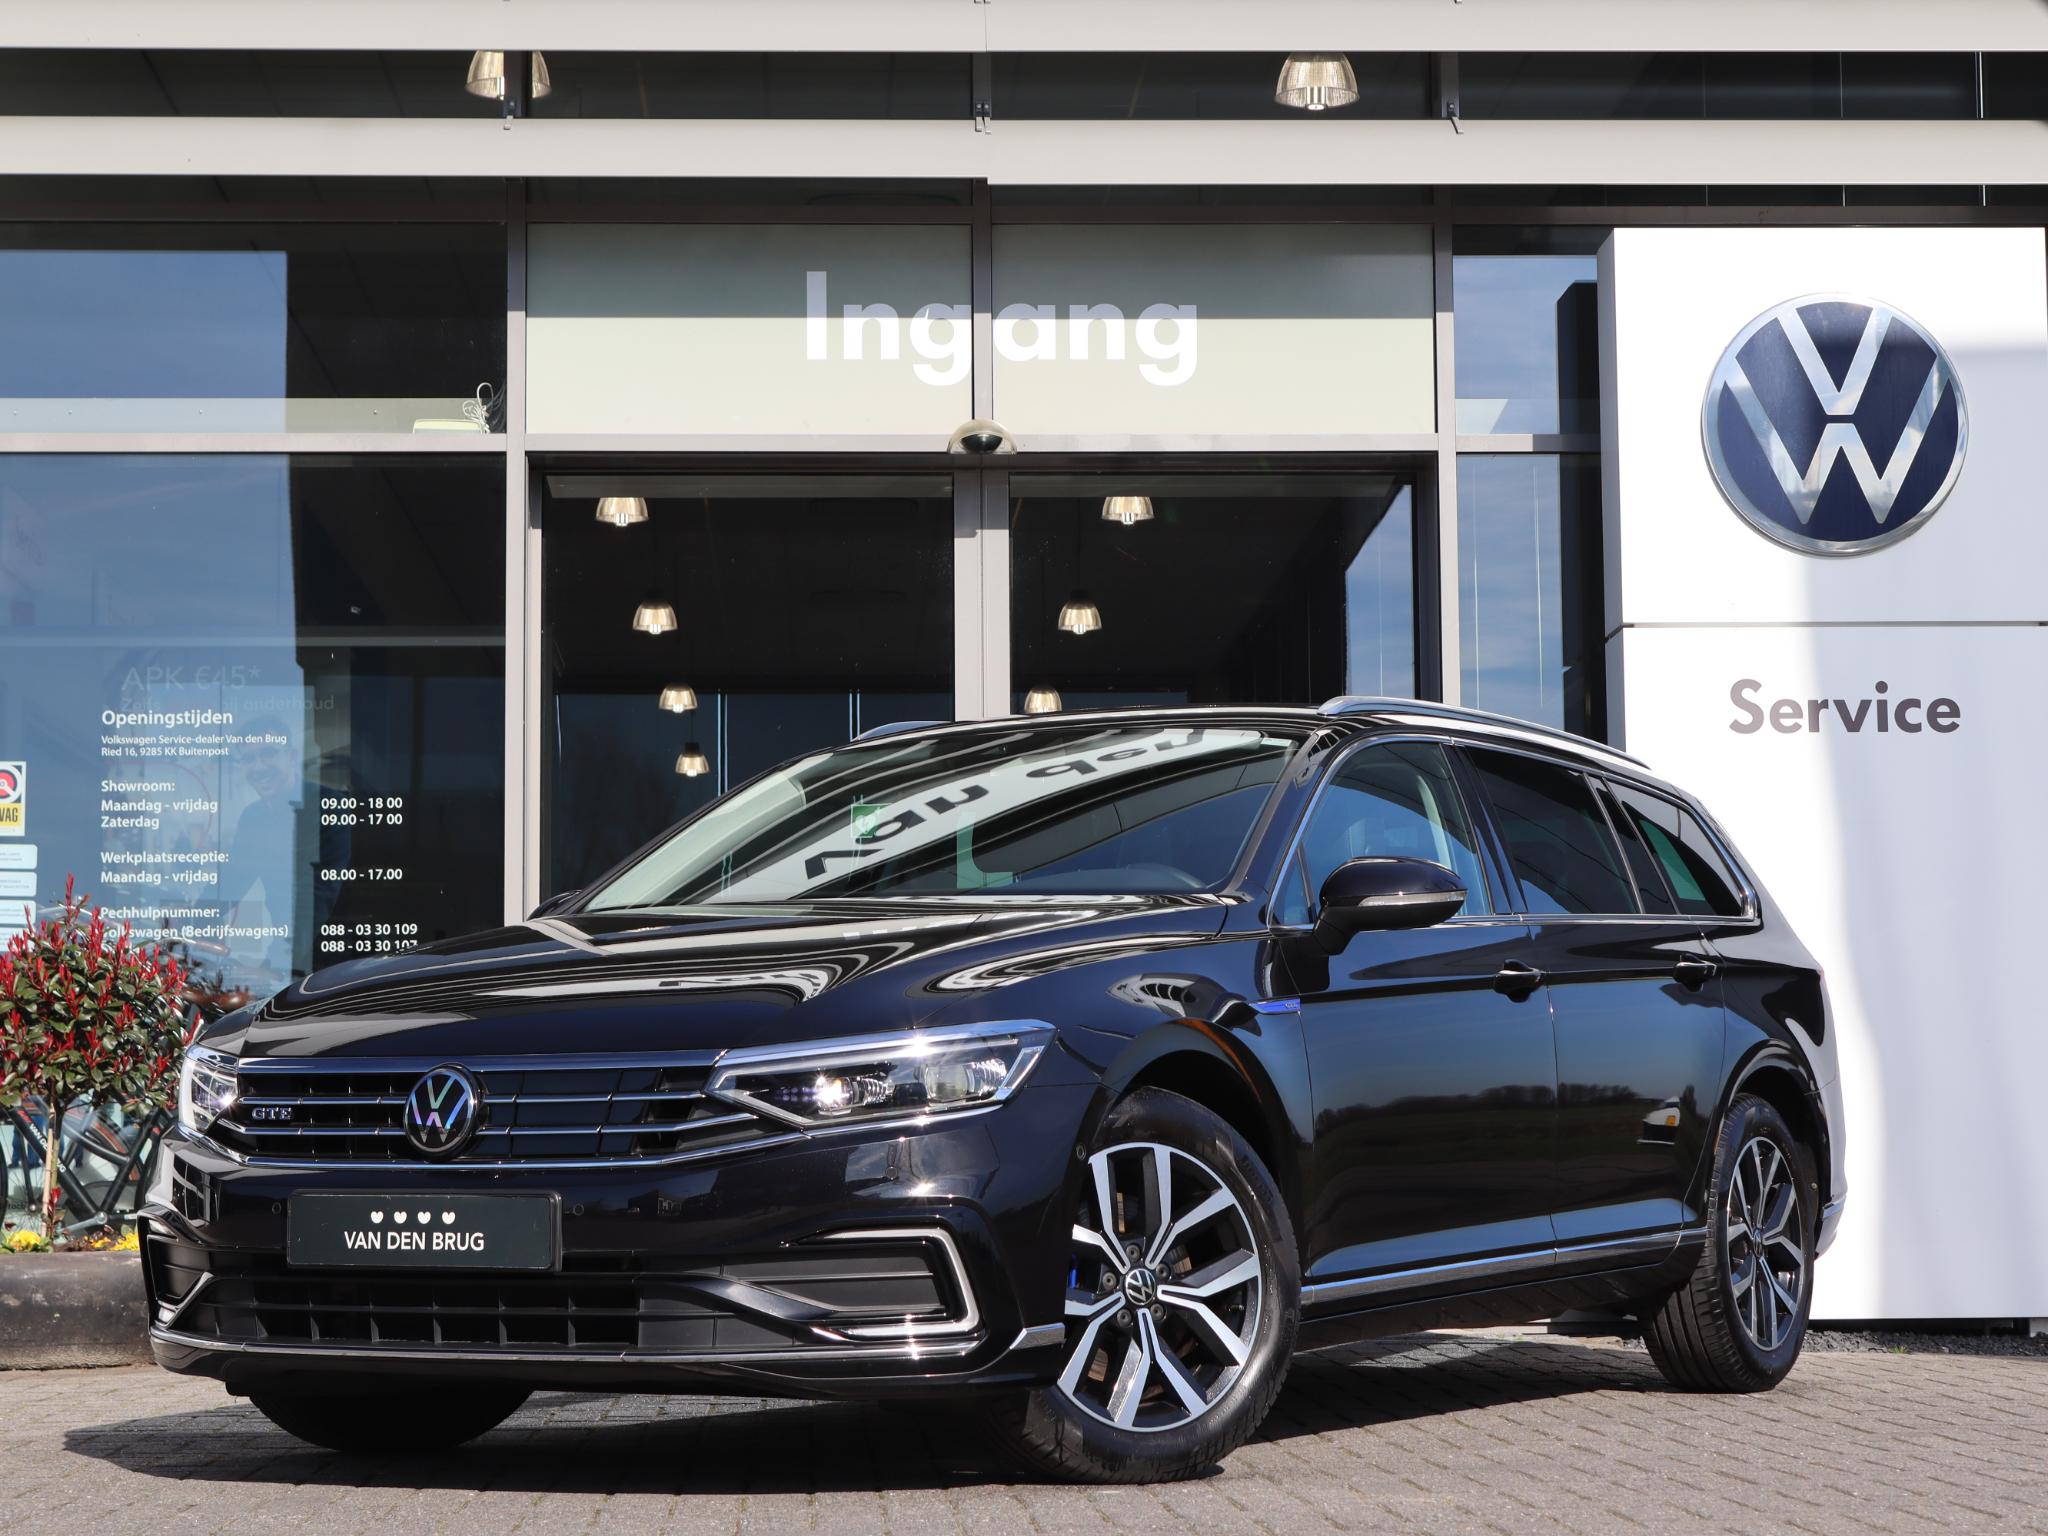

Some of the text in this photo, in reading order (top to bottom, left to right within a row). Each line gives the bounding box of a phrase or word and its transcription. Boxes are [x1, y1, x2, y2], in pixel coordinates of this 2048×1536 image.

[806, 271, 1198, 386] Ingang
[121, 666, 185, 691] APK
[1728, 678, 1961, 735] Service
[101, 709, 233, 728] Openingstijden
[101, 734, 287, 746] Volkswagen Service-dealer Van den Brug
[101, 746, 229, 758] Ried 16, 9285 KK Buitenpost
[101, 780, 176, 792] Showroom:
[101, 799, 162, 814] Maandag
[172, 798, 218, 814] vrijdag
[321, 798, 357, 810] 09.00
[101, 815, 160, 830] Zaterdag
[321, 814, 357, 826] 09.00
[100, 851, 229, 866] Werkplaatsreceptie:
[100, 871, 161, 885] Maandag
[172, 870, 218, 885] vrijdag
[321, 869, 357, 881] 08.00
[368, 868, 403, 881] 17.00
[100, 906, 220, 921] Pechhulpnummer:
[181, 924, 289, 940] (Bedrijfswagens)
[321, 924, 345, 936] 088
[355, 924, 372, 936] 03
[374, 924, 391, 935] 30
[394, 923, 418, 935] 109
[321, 940, 345, 952] 088
[355, 940, 372, 952] 03
[374, 940, 391, 952] 30
[252, 1107, 293, 1121] GTE
[344, 1230, 485, 1251] VAN DEN BRUG
